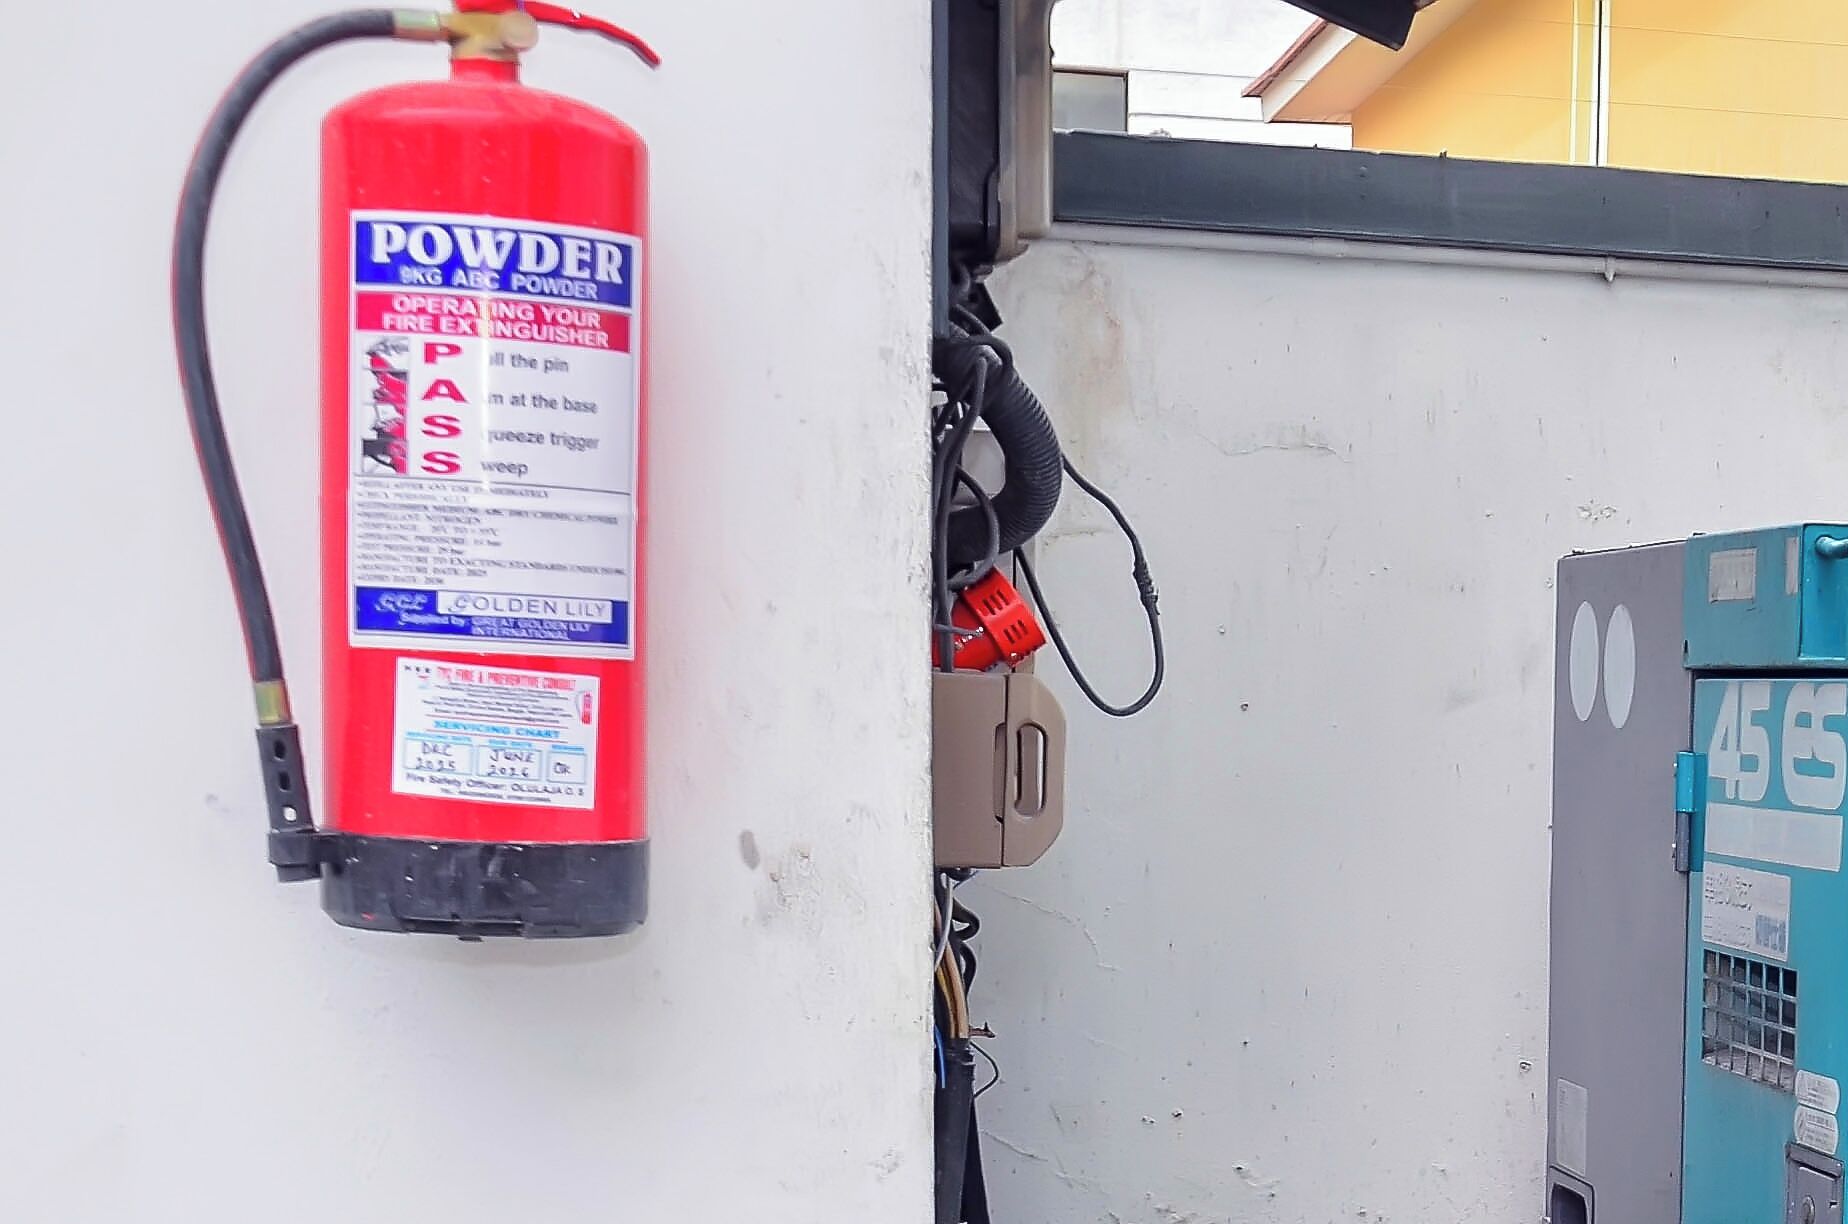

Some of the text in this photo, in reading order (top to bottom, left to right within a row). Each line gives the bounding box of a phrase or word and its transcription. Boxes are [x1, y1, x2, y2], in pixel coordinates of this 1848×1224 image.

[371, 223, 623, 284] POWDER
[453, 269, 500, 290] ABC
[511, 273, 598, 300] POWDER
[392, 294, 601, 329] OPERATING YOUR
[383, 312, 609, 347] FIRE EXTINGUISHER
[424, 342, 464, 364] P
[511, 353, 538, 369] the
[544, 357, 568, 374] pin
[422, 379, 468, 403] A
[510, 394, 526, 407] at
[532, 394, 558, 410] the
[562, 395, 598, 414] base
[421, 415, 463, 438] S
[550, 432, 600, 452] trigger
[421, 451, 463, 474] S
[566, 601, 606, 617] LILY
[434, 720, 511, 735] SERVICING
[1707, 683, 1771, 802] 45
